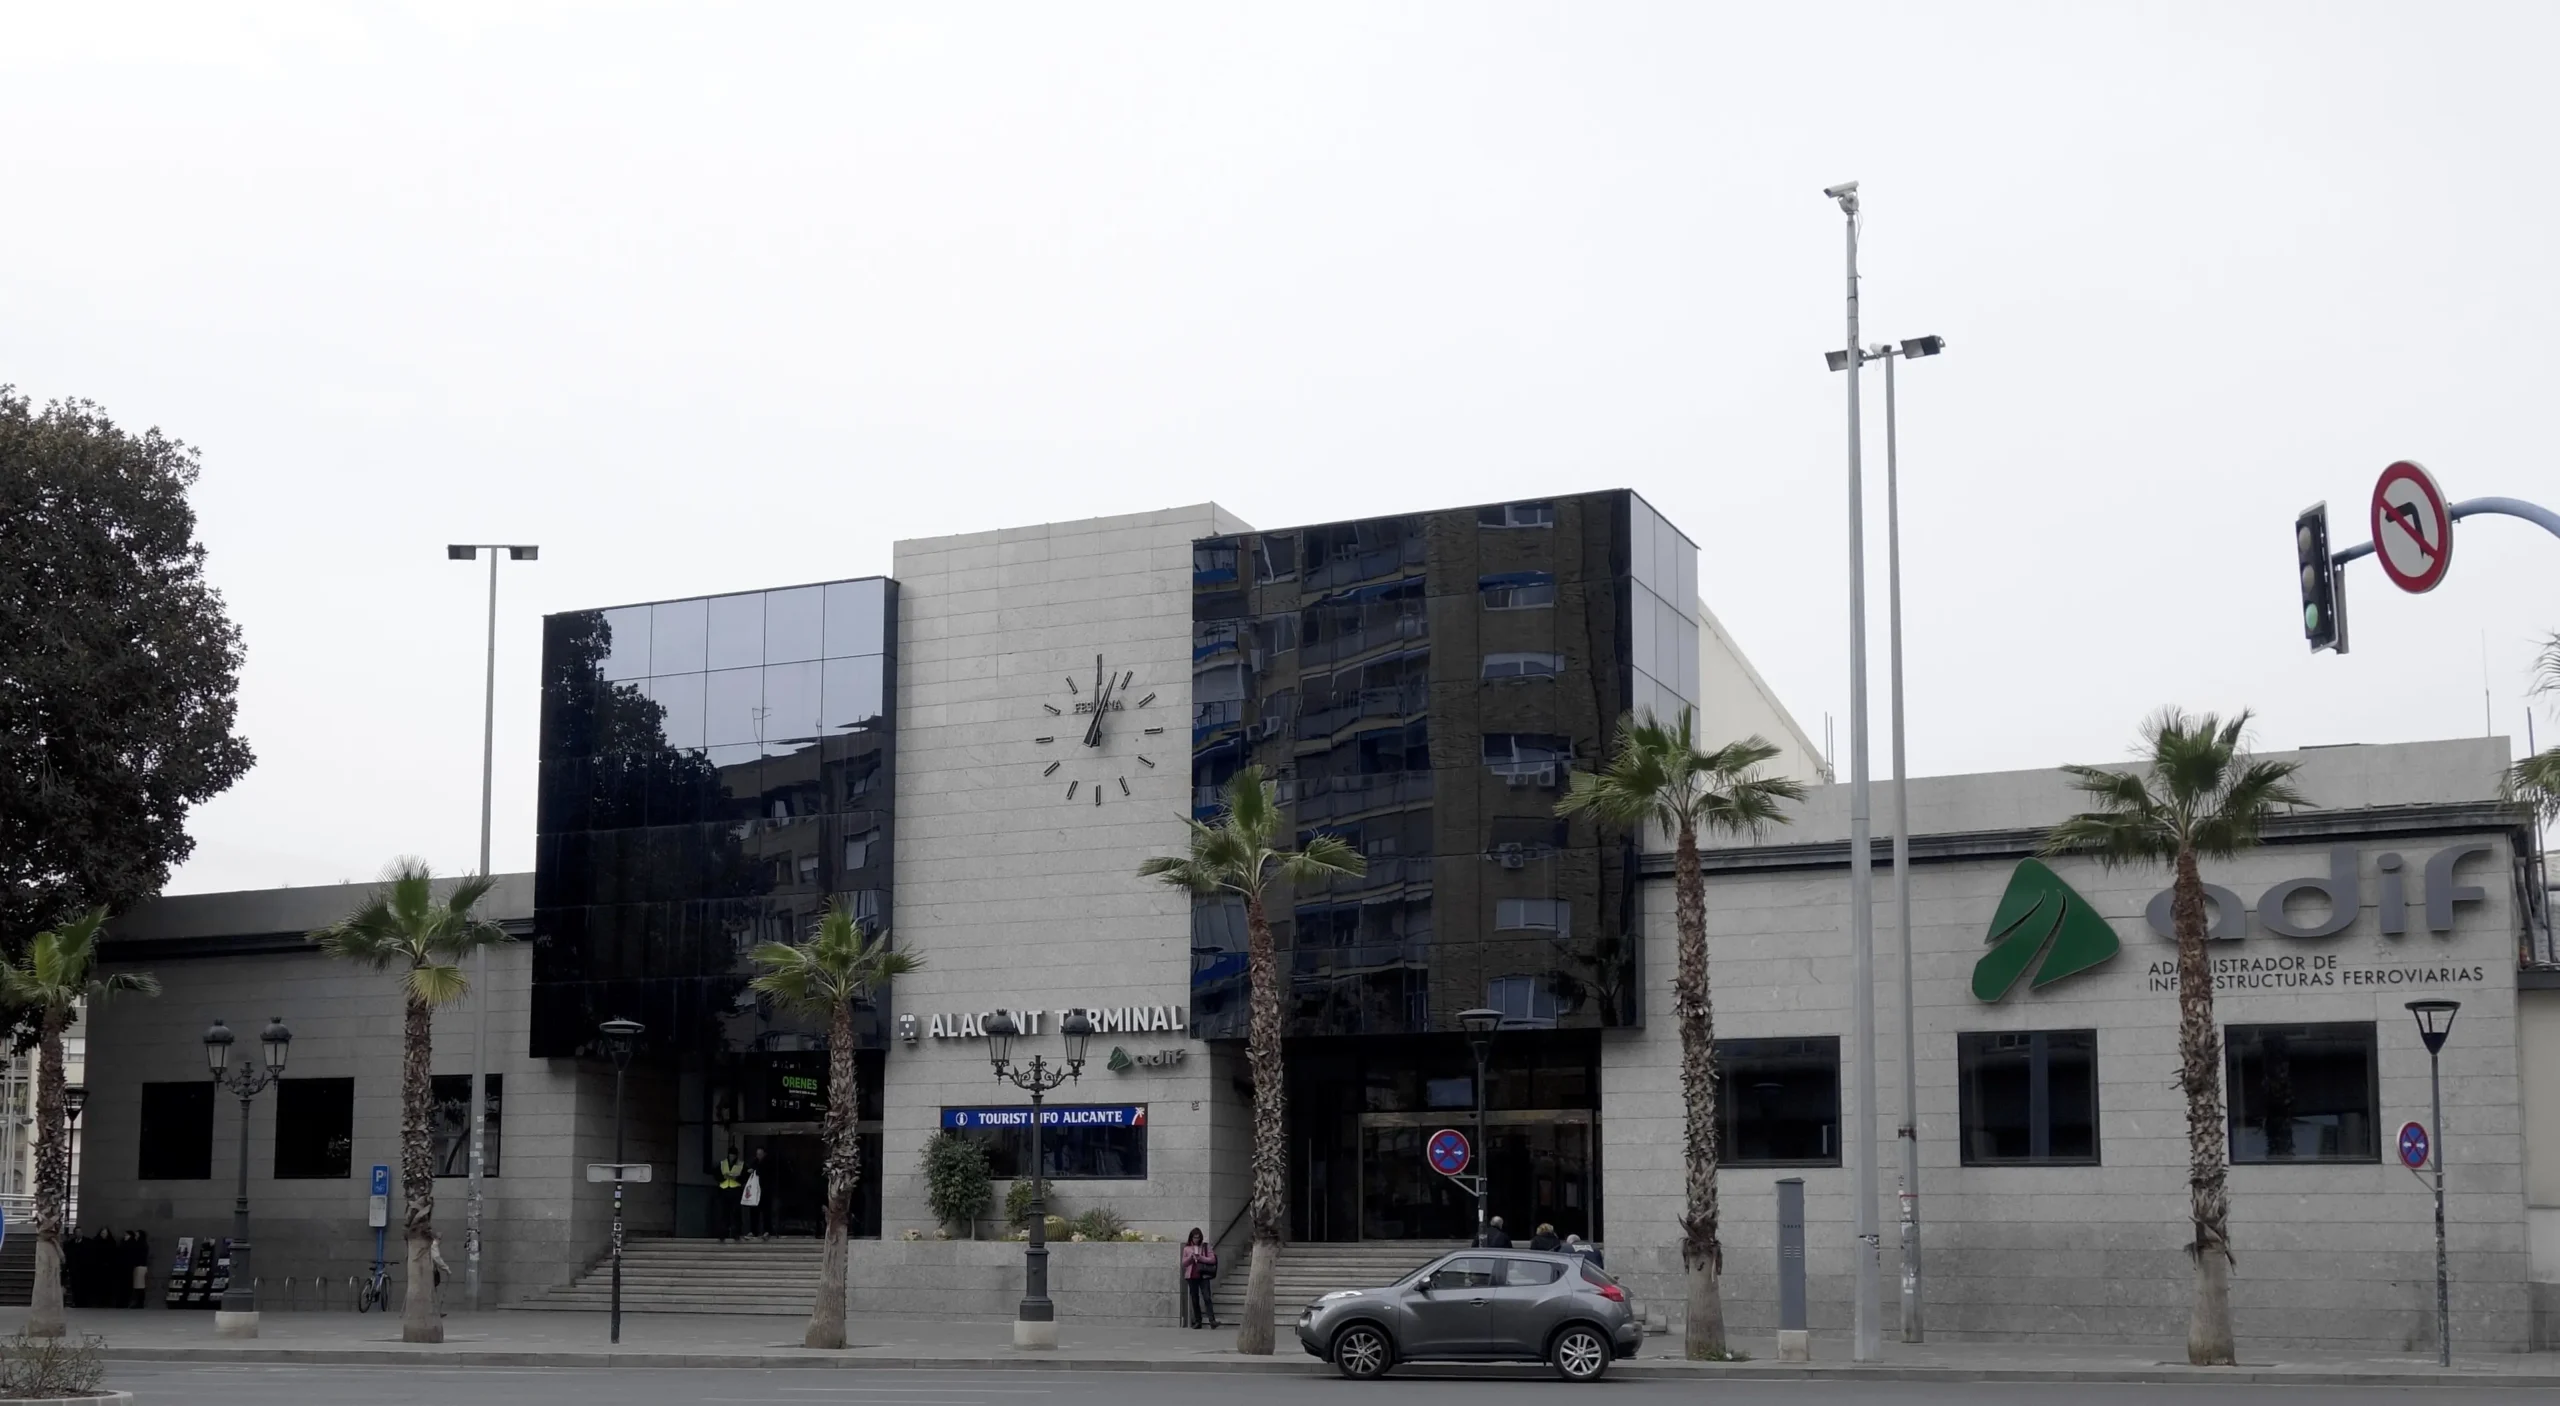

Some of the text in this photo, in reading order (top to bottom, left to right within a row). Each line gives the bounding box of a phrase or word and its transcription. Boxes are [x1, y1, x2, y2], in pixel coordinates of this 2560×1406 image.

[2145, 842, 2493, 941] adif
[2148, 954, 2337, 976] ADISTRADOR DE
[2149, 966, 2484, 992] INFSTRUCTURAS FERROVIARIAS
[928, 1005, 1184, 1038] ALACNT TRMINAL
[1132, 1049, 1186, 1066] adif
[782, 1075, 818, 1091] ORENES
[978, 1112, 1027, 1125] TOURIST
[1063, 1110, 1123, 1124] ALICANTE
